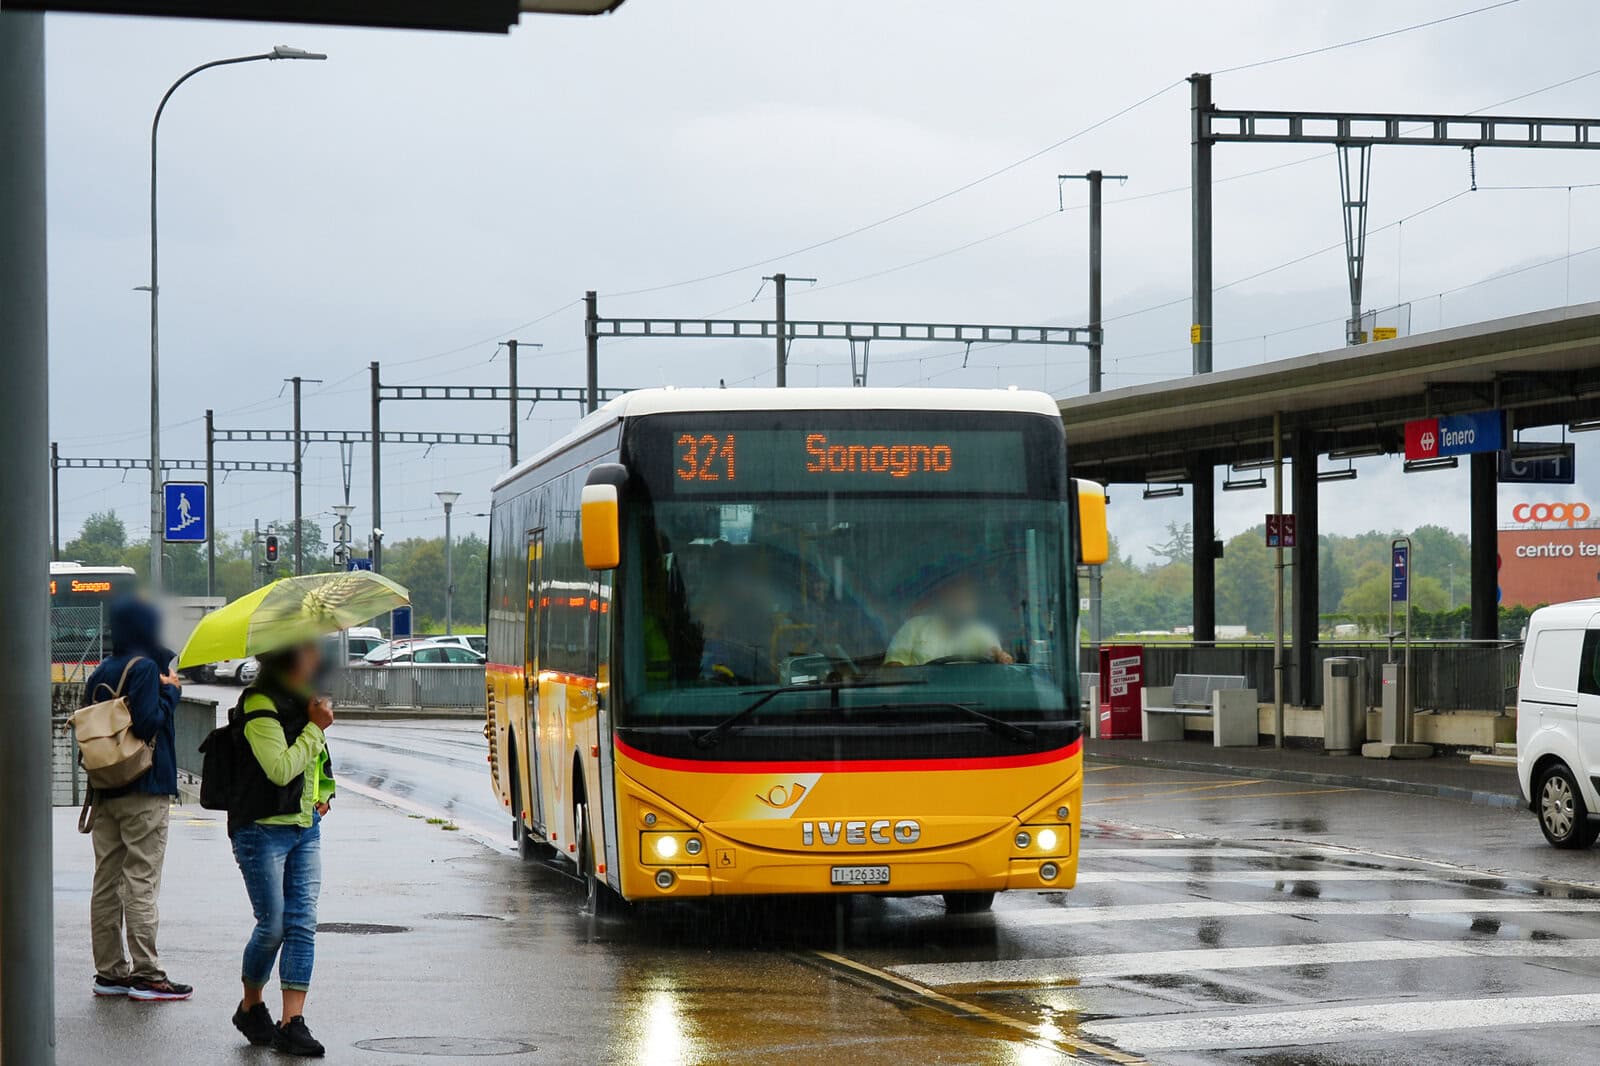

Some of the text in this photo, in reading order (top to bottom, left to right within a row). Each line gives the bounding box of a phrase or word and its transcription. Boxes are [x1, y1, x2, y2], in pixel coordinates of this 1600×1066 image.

[1440, 428, 1475, 447] Tenero
[677, 433, 952, 480] 321 Sonogno
[1512, 502, 1591, 527] coop
[1516, 542, 1574, 558] centro
[71, 580, 111, 592] Sonogno
[802, 820, 921, 846] IVECO
